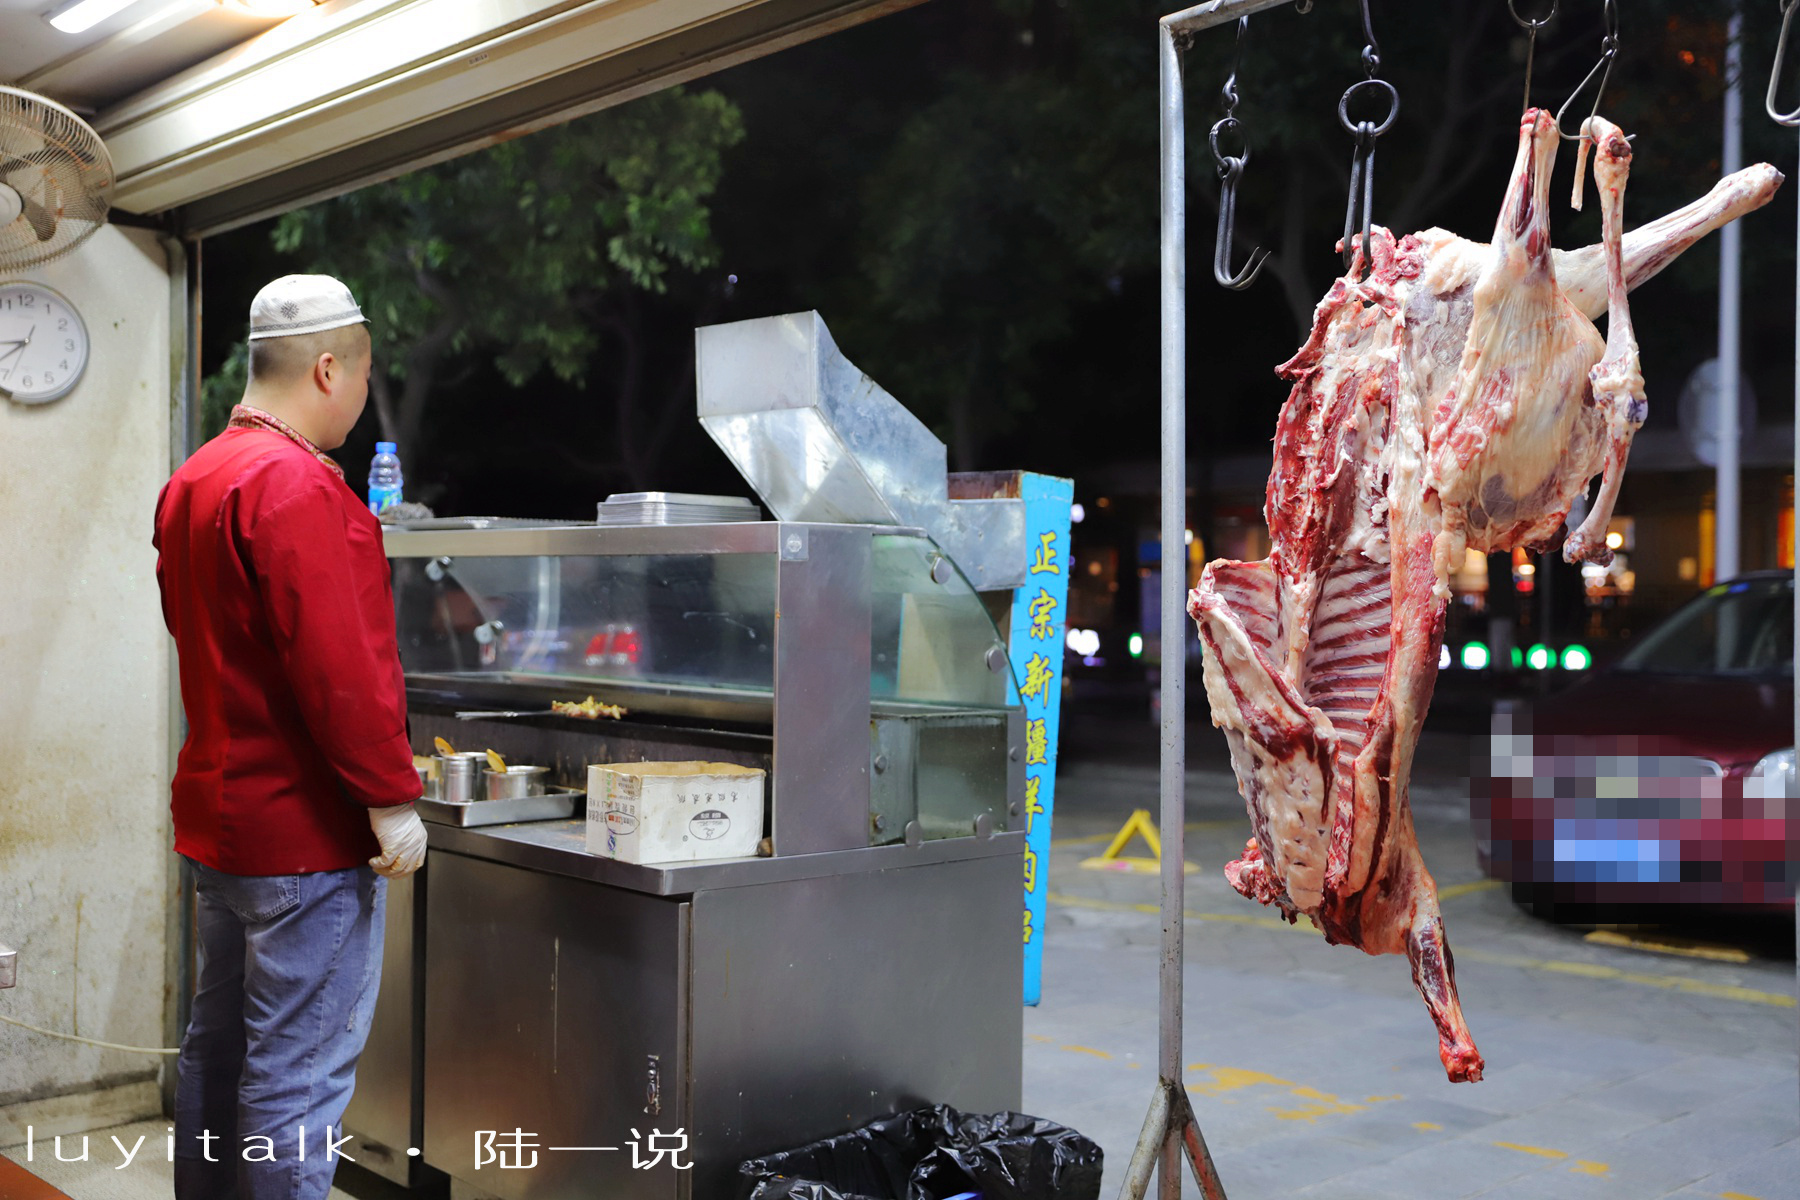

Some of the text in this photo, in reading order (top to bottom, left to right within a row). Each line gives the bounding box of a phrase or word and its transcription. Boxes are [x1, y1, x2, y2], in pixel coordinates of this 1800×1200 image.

[17, 294, 35, 308] 12
[44, 303, 51, 315] 1
[58, 317, 68, 331] 2
[64, 338, 75, 352] 3
[59, 359, 69, 370] 4
[0, 368, 10, 380] 7
[44, 371, 54, 384] 5
[22, 375, 33, 388] 6
